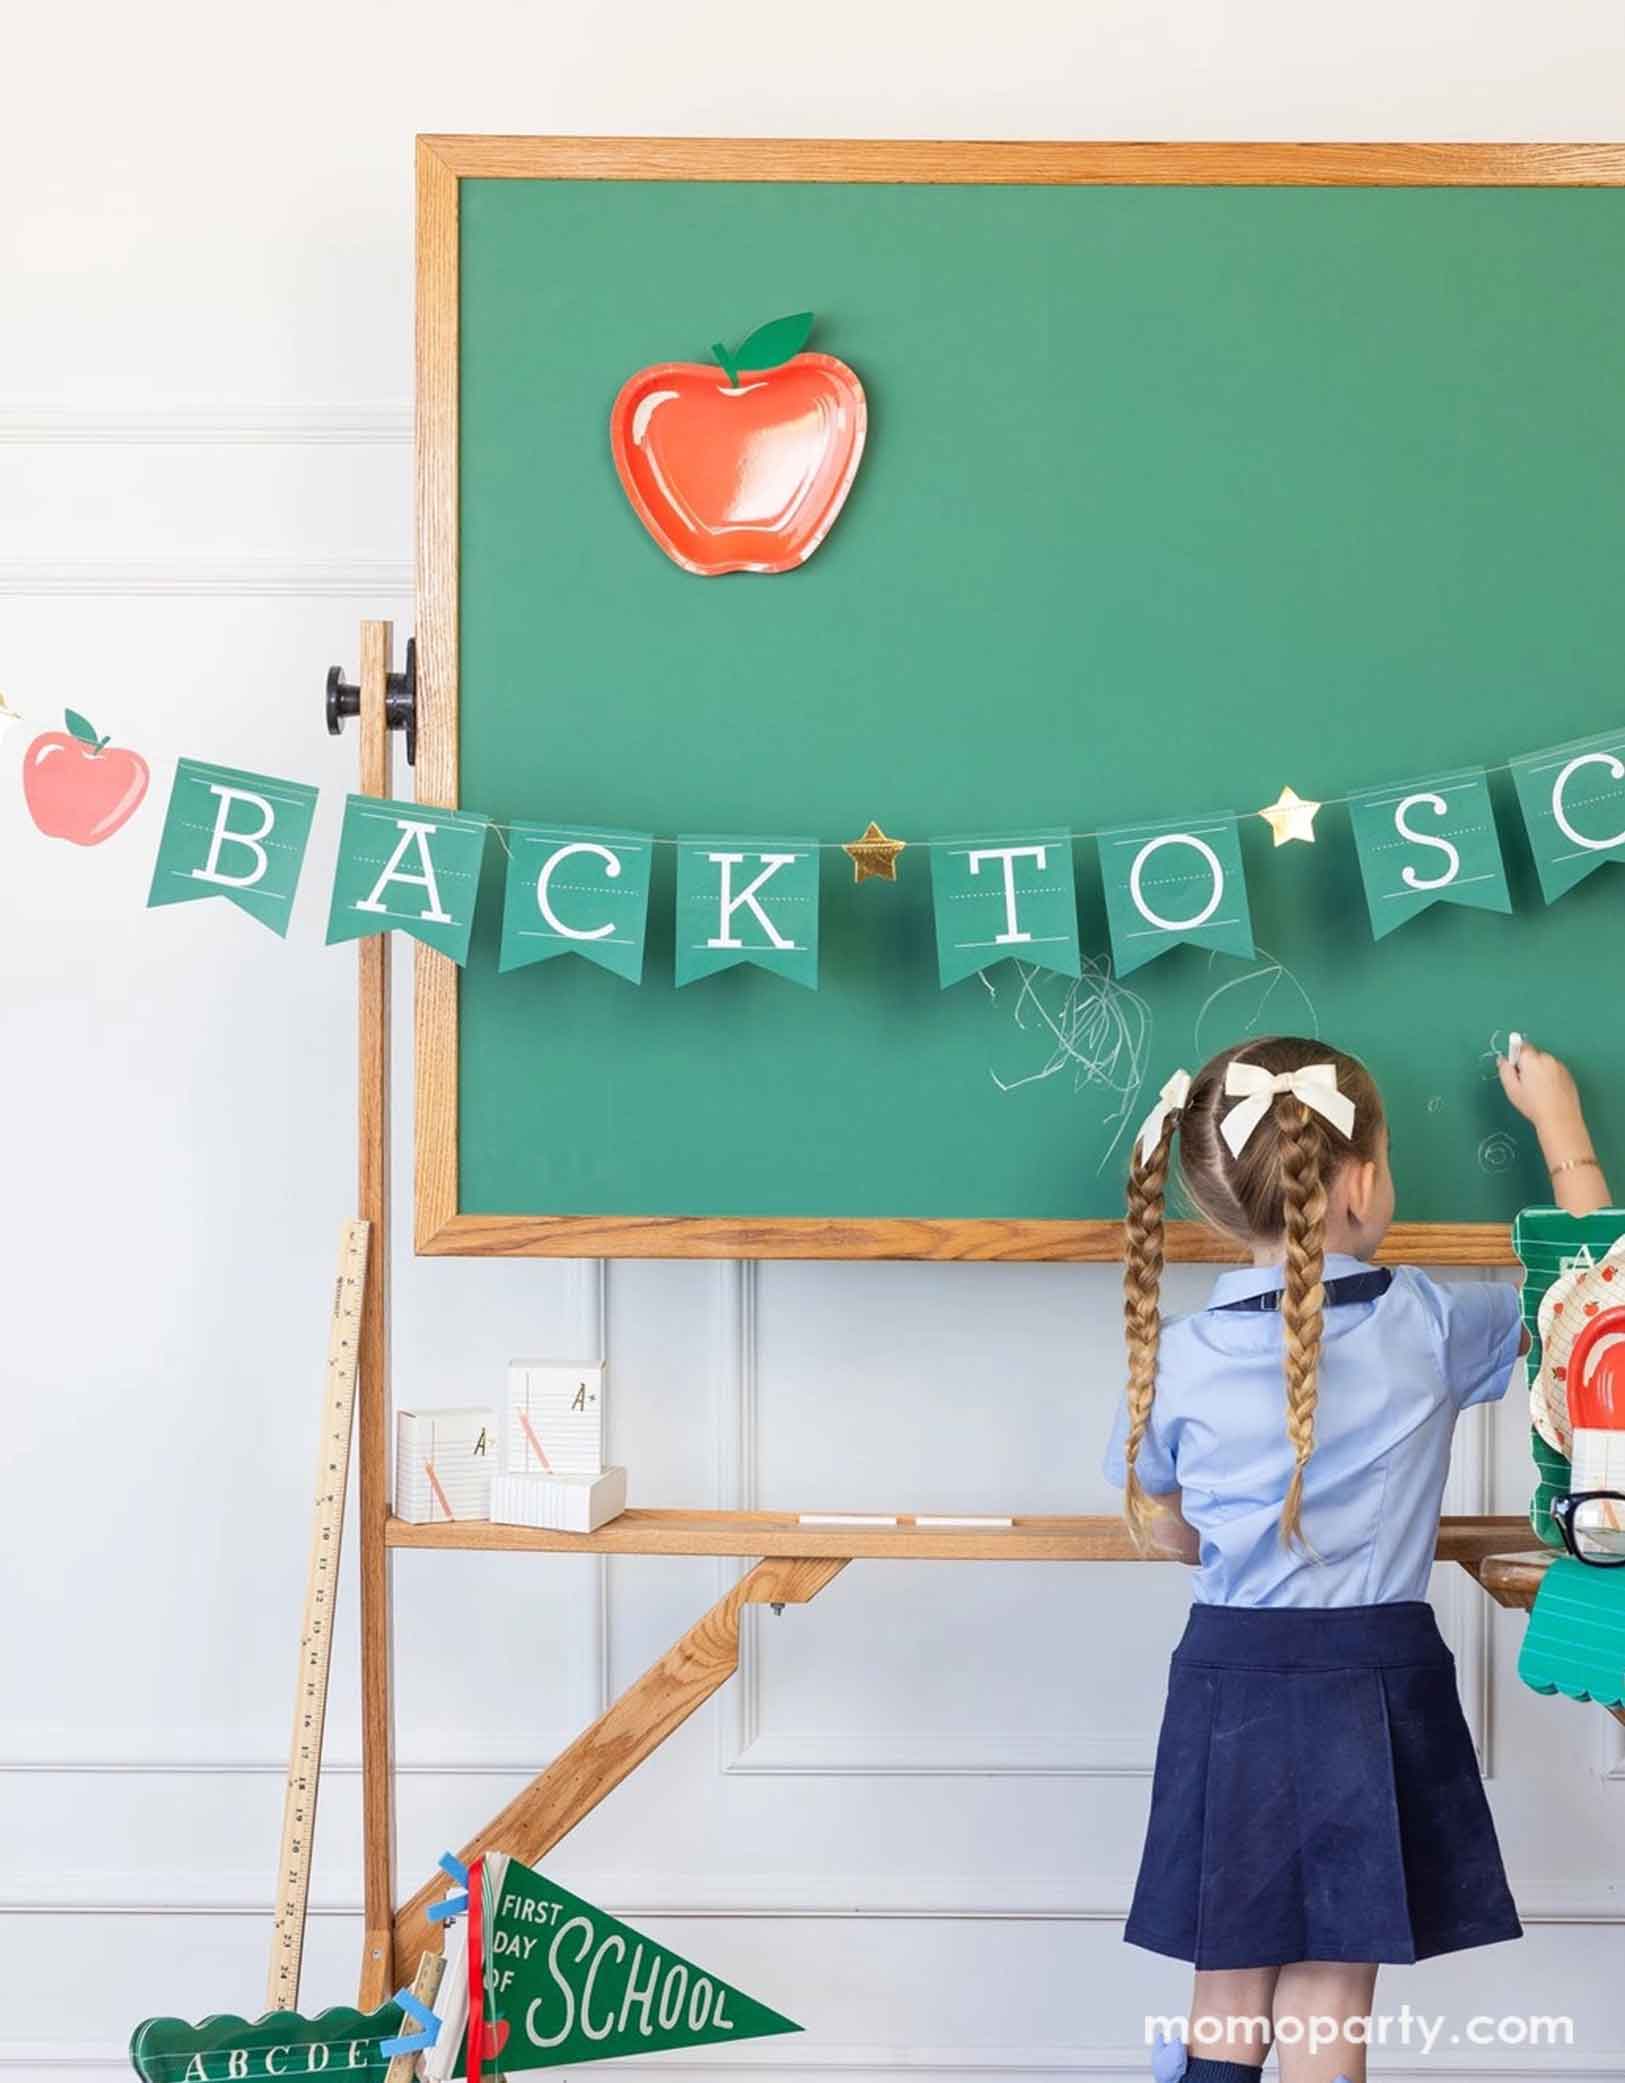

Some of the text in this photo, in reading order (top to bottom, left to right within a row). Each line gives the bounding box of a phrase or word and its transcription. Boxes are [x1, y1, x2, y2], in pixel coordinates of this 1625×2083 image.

[191, 784, 796, 949] BACK
[968, 834, 1224, 943] TO
[494, 1931, 538, 1960] DAY
[501, 1894, 563, 1926] FIRST
[525, 1916, 734, 2048] SCHOOL
